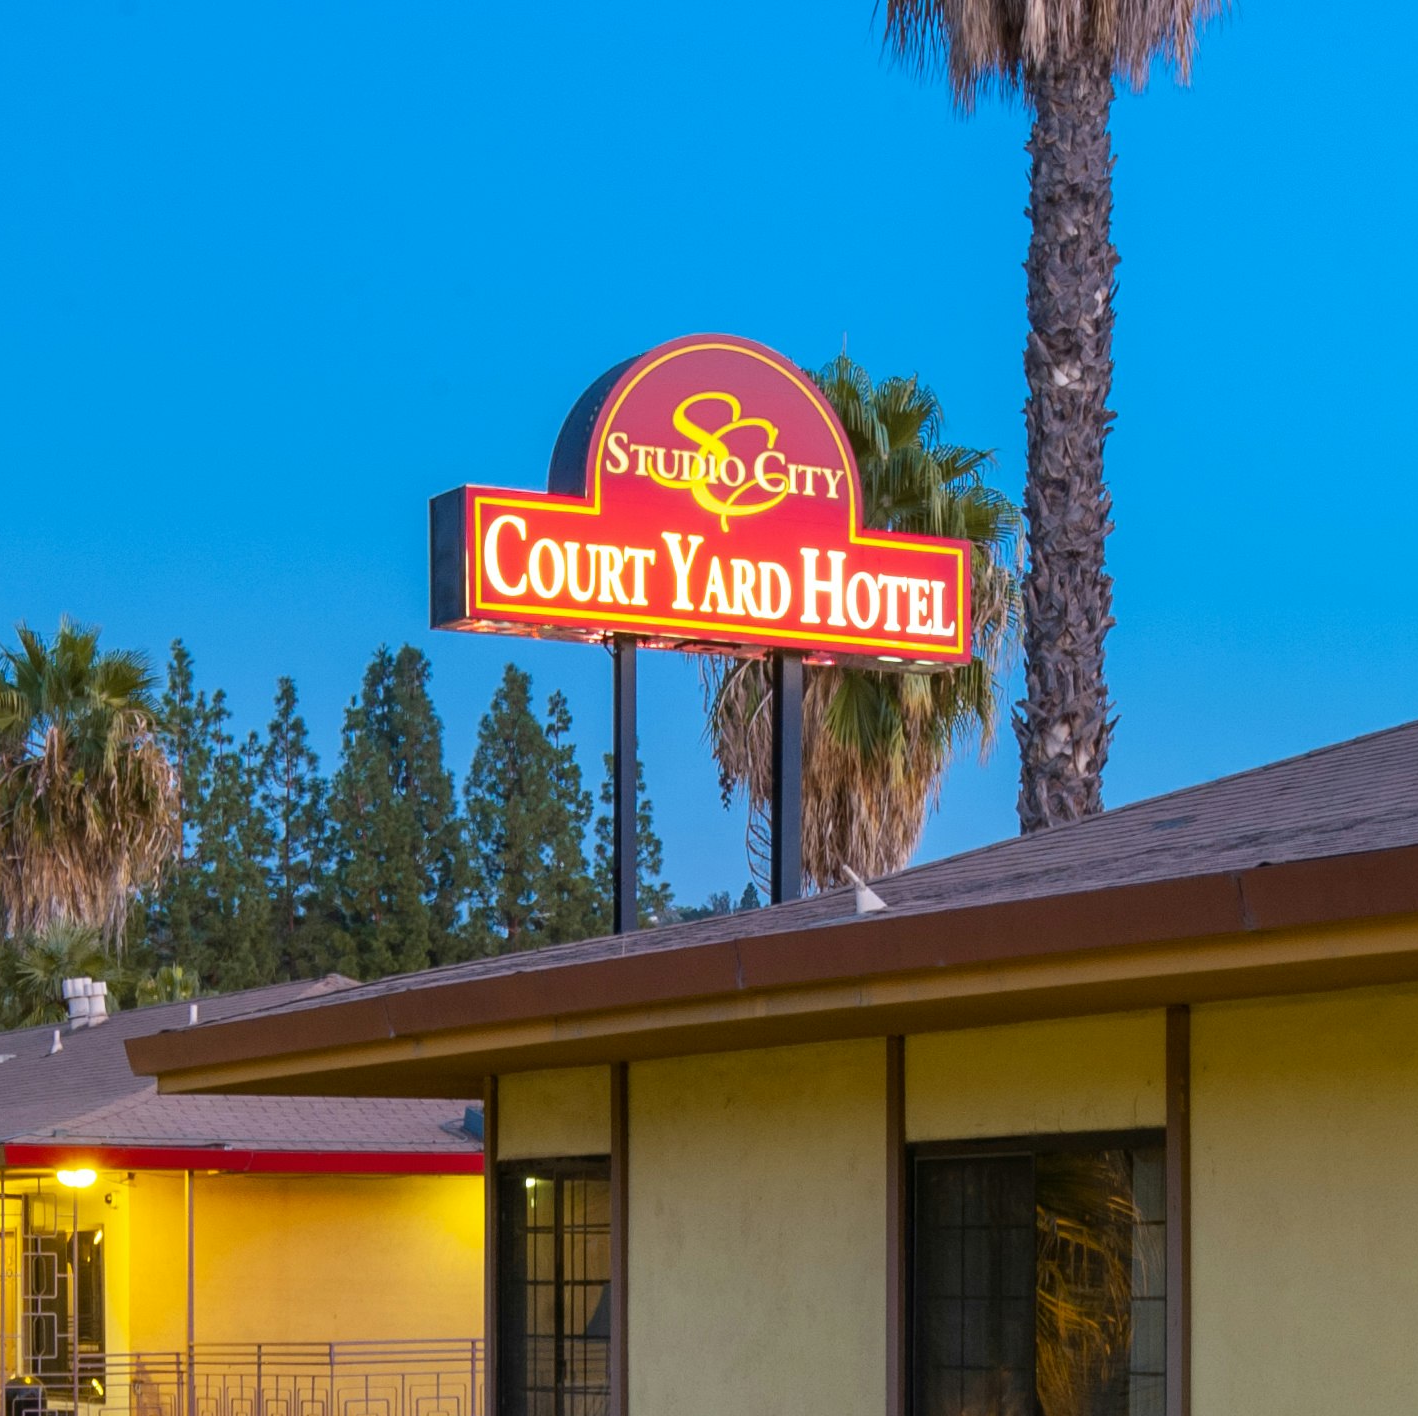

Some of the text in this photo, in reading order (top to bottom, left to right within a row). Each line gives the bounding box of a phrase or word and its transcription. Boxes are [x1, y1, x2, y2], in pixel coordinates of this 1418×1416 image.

[606, 432, 845, 499] STUDIO CITY
[484, 514, 956, 637] COURT YARD HOTEL
